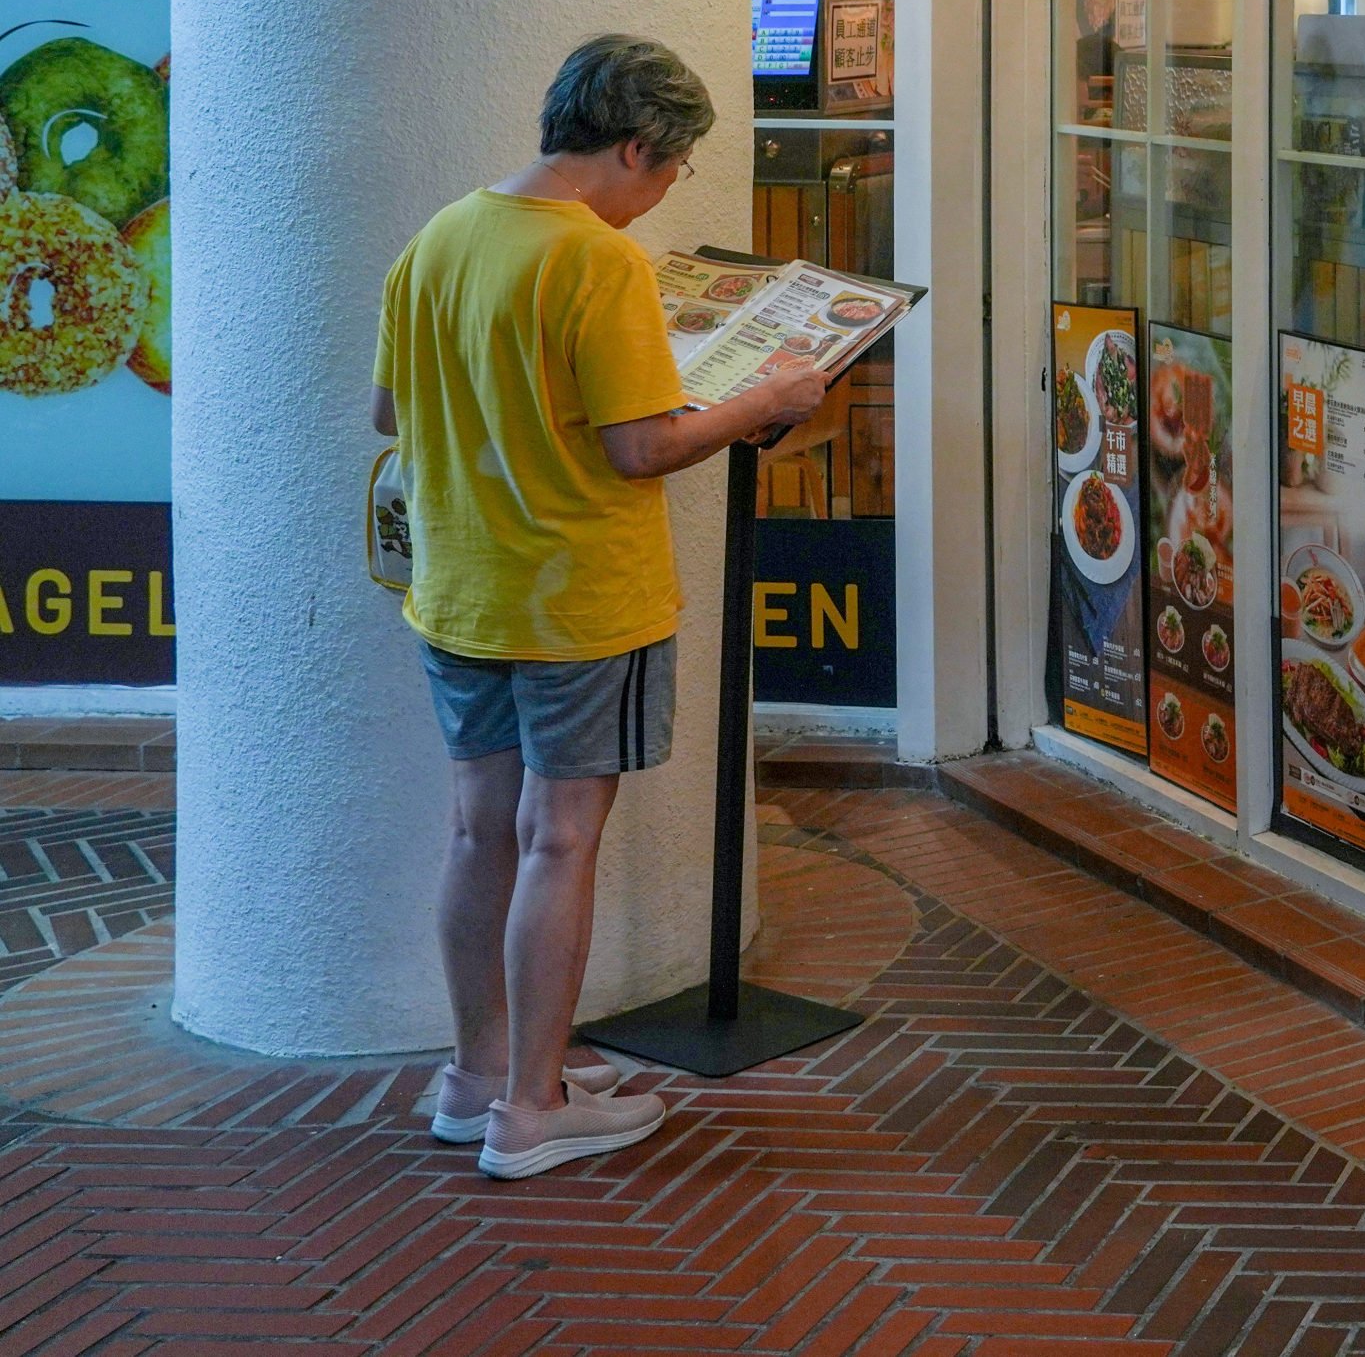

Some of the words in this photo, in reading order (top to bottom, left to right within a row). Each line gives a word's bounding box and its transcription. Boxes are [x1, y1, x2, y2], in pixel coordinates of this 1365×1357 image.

[834, 18, 876, 41] 員工通道
[834, 45, 875, 69] 顧客止步
[1292, 390, 1317, 418] 早晨
[1106, 429, 1126, 452] 午市
[1292, 416, 1318, 444] 之選
[1105, 452, 1127, 477] 精選
[0, 568, 176, 636] GEL
